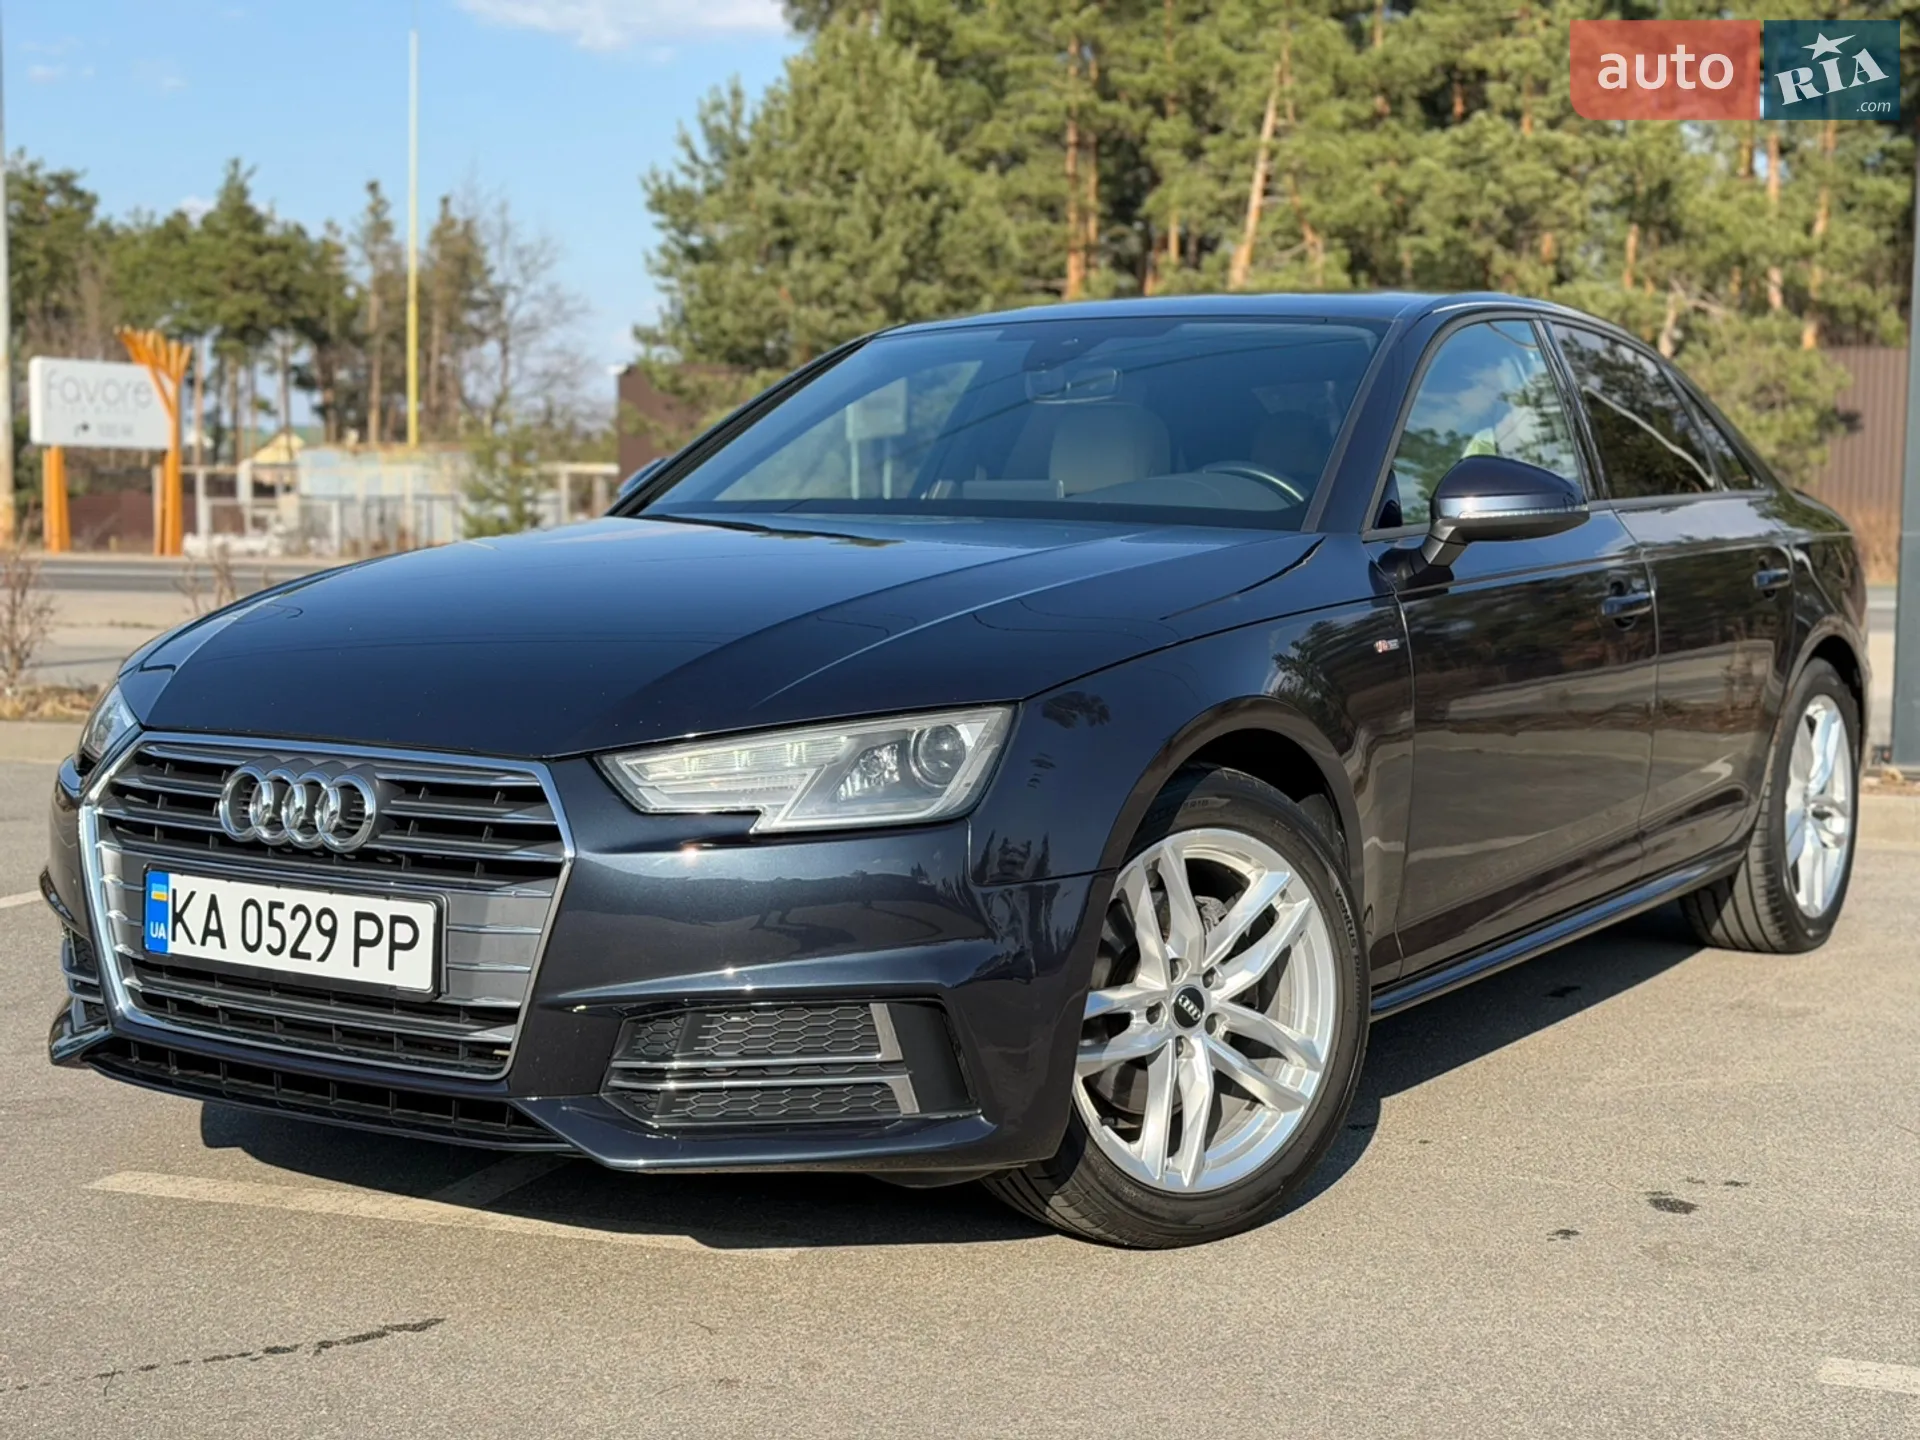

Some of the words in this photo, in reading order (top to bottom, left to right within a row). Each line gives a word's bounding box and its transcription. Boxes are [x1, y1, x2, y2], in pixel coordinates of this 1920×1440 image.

[150, 921, 167, 940] UA
[171, 888, 227, 950] KA
[241, 898, 338, 963] 0529
[353, 910, 420, 971] PP
